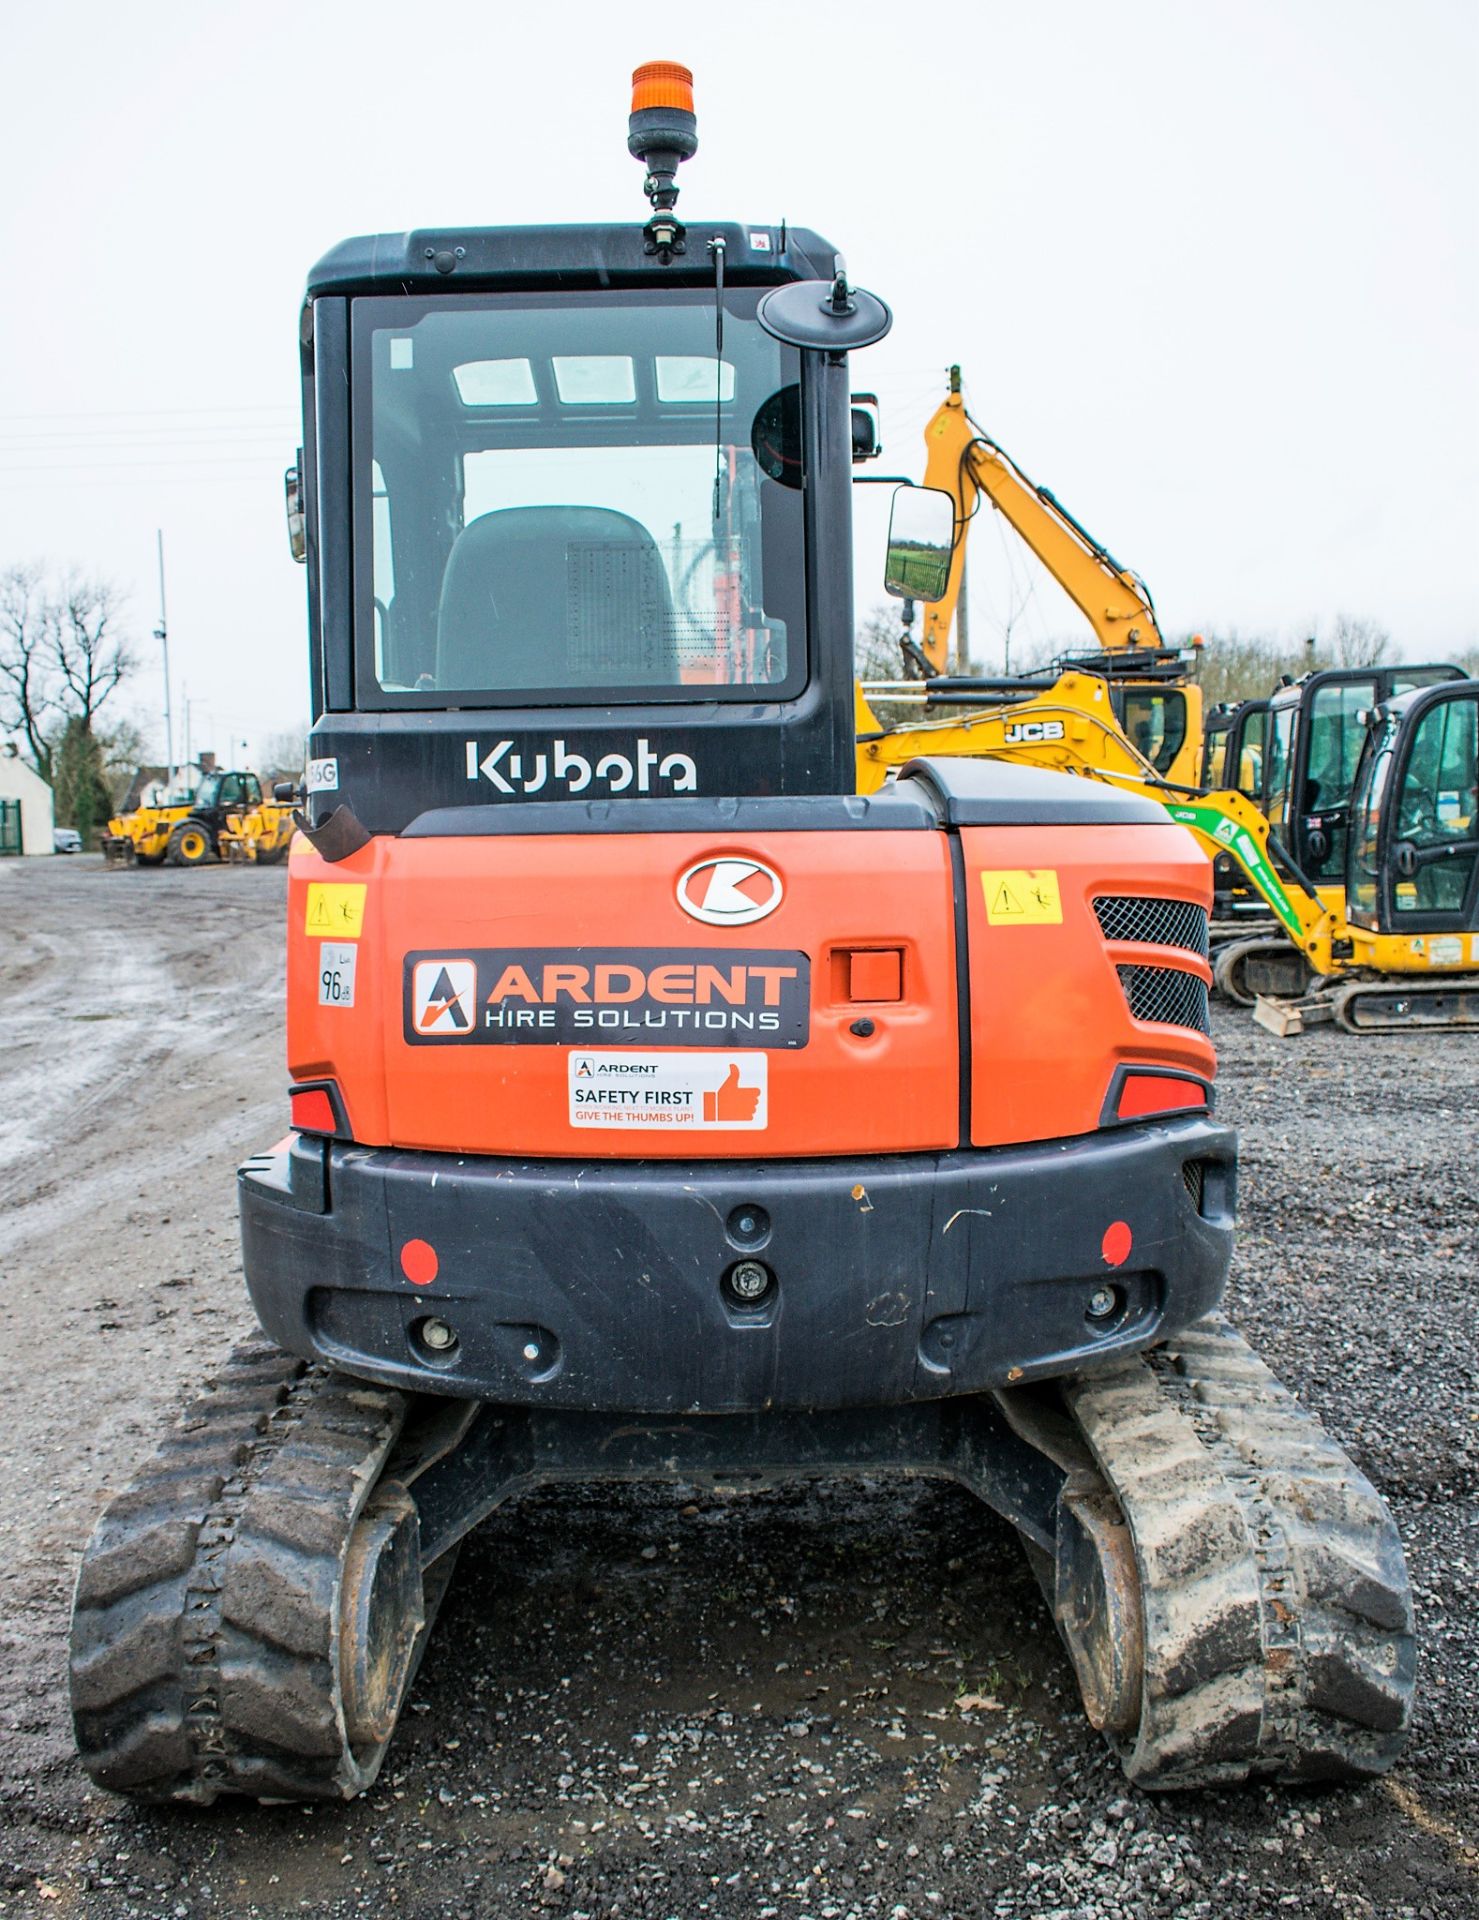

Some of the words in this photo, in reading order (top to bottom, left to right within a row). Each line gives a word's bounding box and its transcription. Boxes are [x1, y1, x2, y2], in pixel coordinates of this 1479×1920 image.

[1005, 721, 1064, 743] JCB
[465, 739, 698, 793] Kubota
[322, 970, 341, 1001] 96
[487, 965, 798, 1006] ARDENT
[485, 1009, 556, 1028] HIRE
[574, 1009, 780, 1031] SOLUTIONS
[598, 1064, 659, 1074] ARDENT
[575, 1089, 640, 1104] SAFETY
[645, 1091, 693, 1104] FIRST
[575, 1111, 601, 1121] GIVE
[602, 1112, 624, 1121] THE
[626, 1112, 673, 1122] THUMBS
[676, 1113, 694, 1123] UP!
